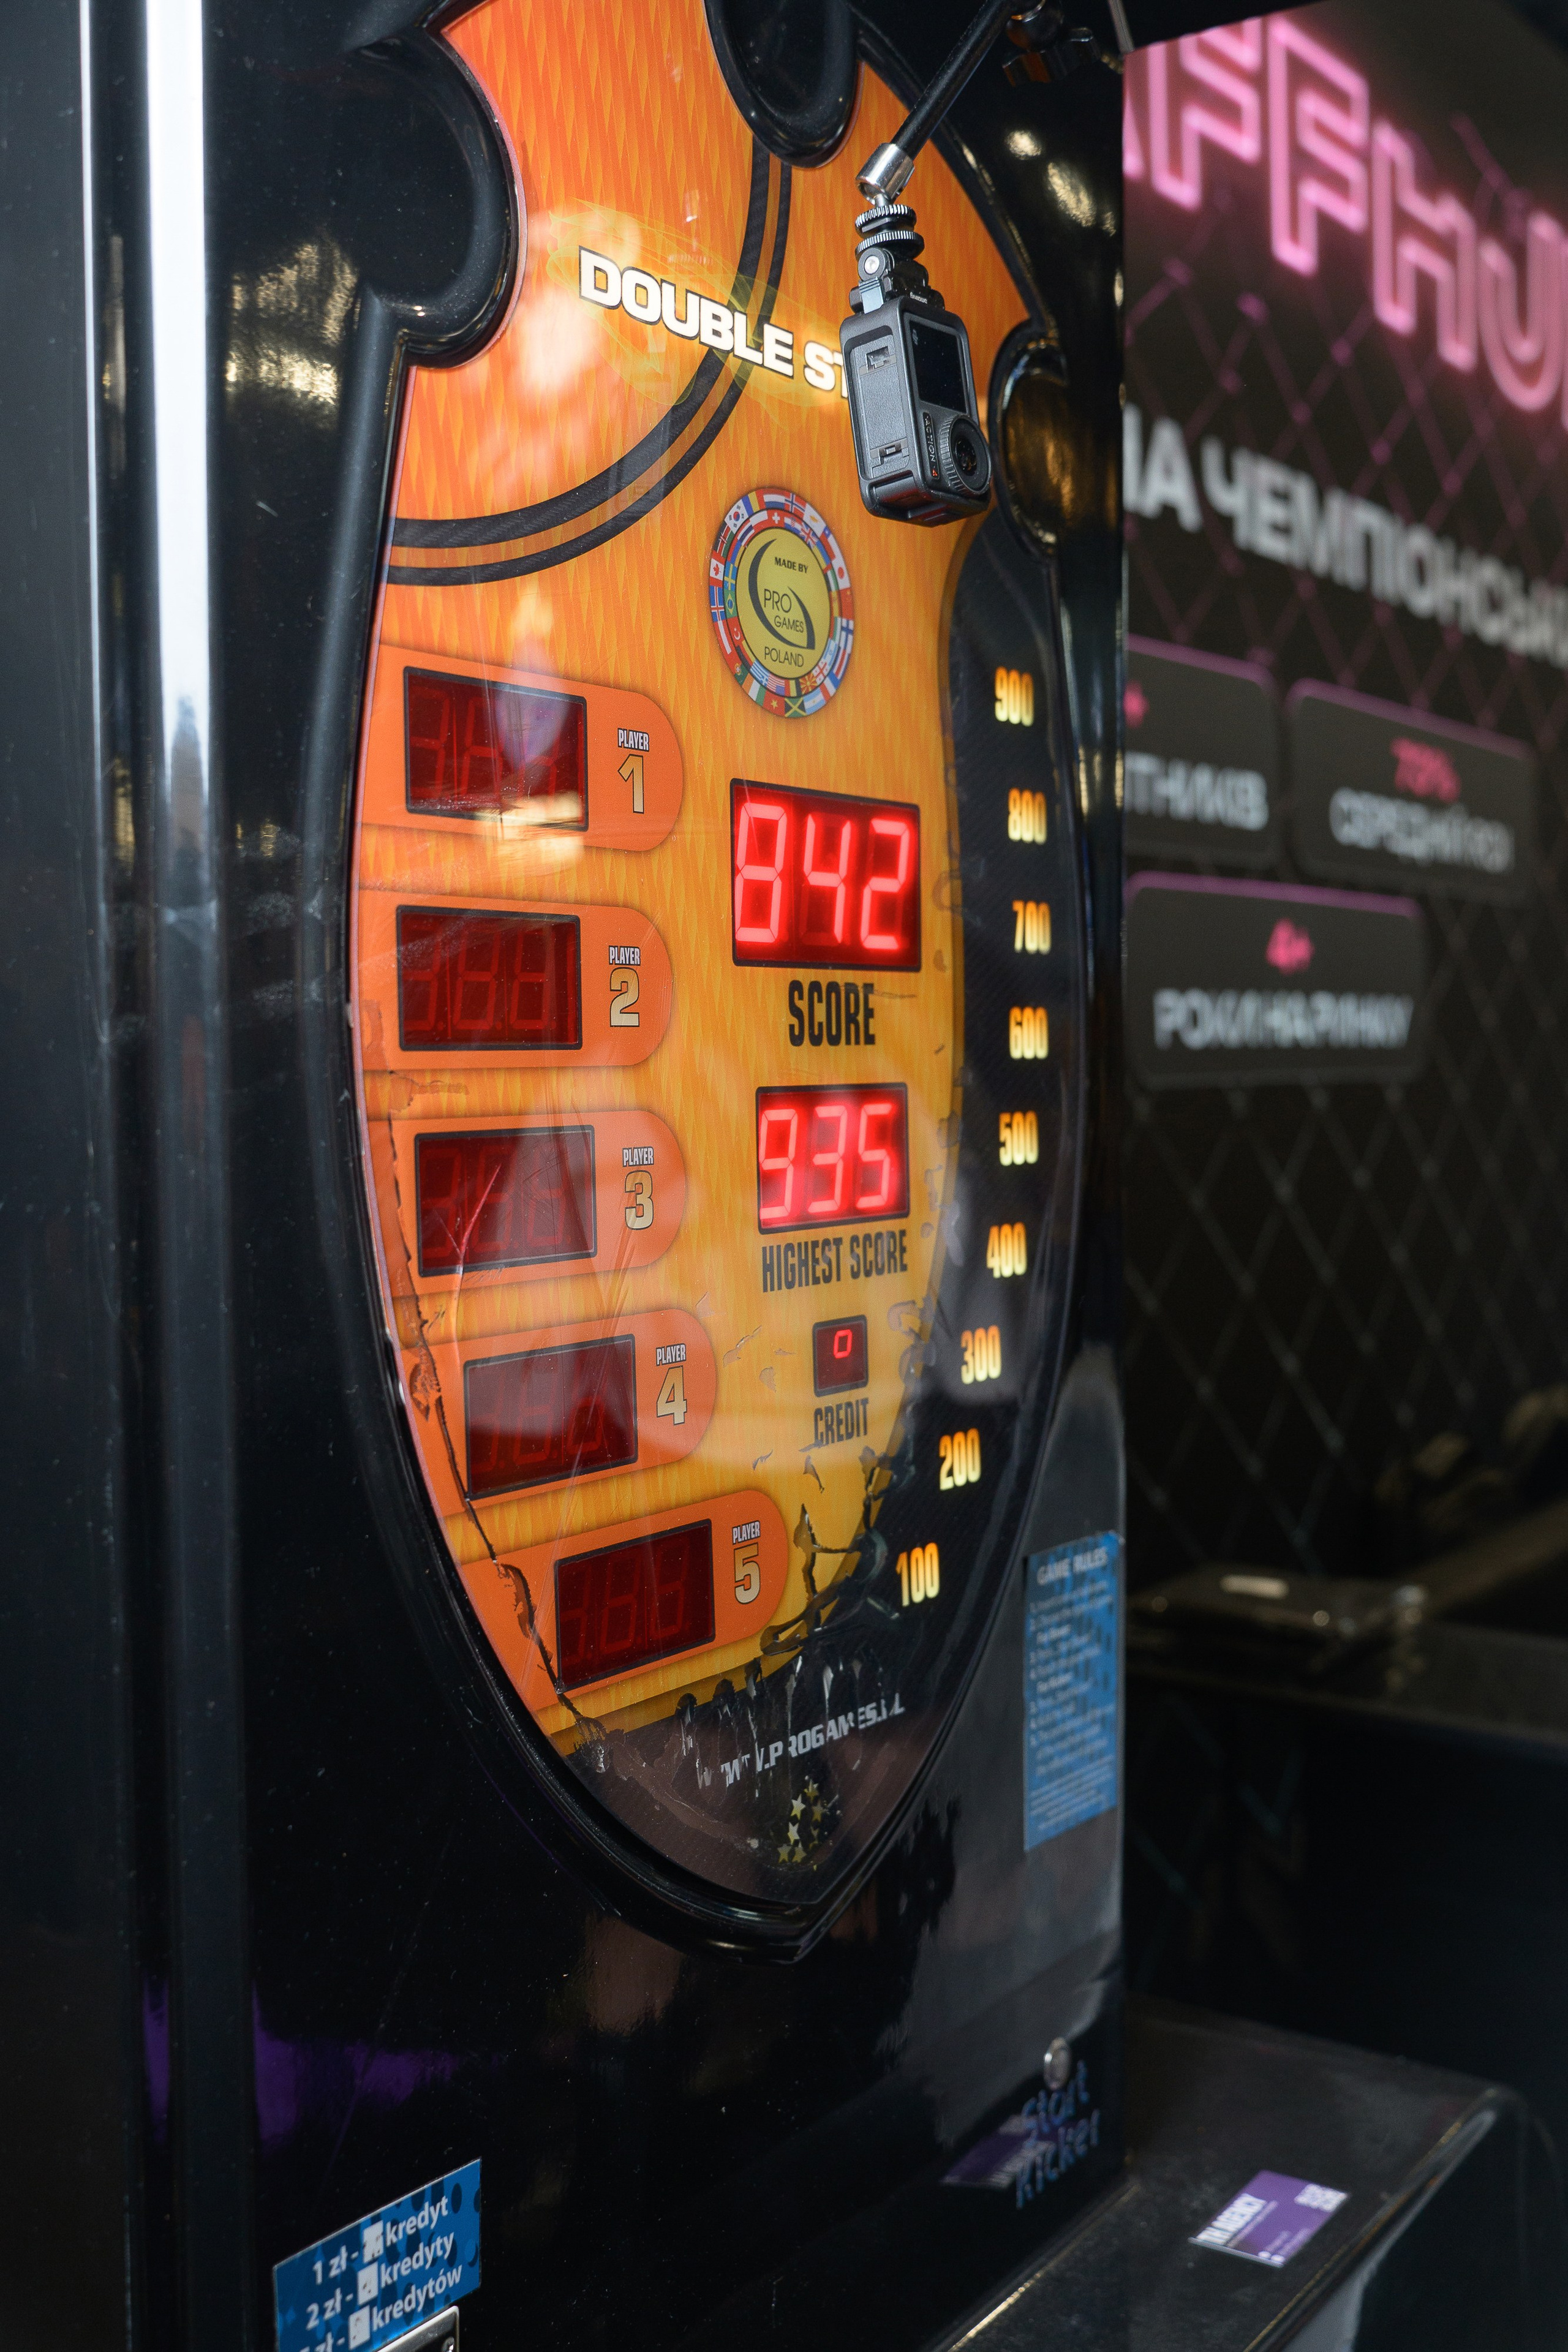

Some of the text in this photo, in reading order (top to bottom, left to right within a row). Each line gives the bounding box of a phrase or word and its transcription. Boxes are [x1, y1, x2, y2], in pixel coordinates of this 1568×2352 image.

[579, 246, 794, 379] DOUBLE
[774, 557, 809, 575] MADE BY
[764, 588, 792, 614] PRO
[774, 614, 804, 633] GAMES
[764, 646, 805, 668] POLAND
[995, 666, 1034, 727] 900
[618, 728, 649, 752] PLAYER
[617, 753, 644, 813] 1
[1008, 788, 1047, 845] 800
[735, 802, 910, 951] 842
[609, 945, 641, 967] PLAYER
[1012, 900, 1052, 955] 700
[609, 967, 641, 1027] 2
[788, 980, 876, 1047] SCORE
[1009, 1006, 1048, 1060] 600
[623, 1147, 654, 1167] PLAYER
[760, 1103, 894, 1219] 935
[999, 1110, 1039, 1166] 500
[624, 1170, 654, 1230] 3
[762, 1230, 908, 1293] HIGHEST SCORE
[987, 1222, 1027, 1279] 400
[655, 1343, 687, 1366] PLAYER
[834, 1329, 852, 1359] 0
[961, 1325, 1001, 1385] 300
[656, 1366, 687, 1425] 4
[813, 1398, 869, 1447] CREDIT
[940, 1428, 981, 1491] 200
[732, 1520, 761, 1544] PLAYER
[734, 1543, 761, 1605] 5
[896, 1542, 940, 1607] 100
[312, 2260, 323, 2285] 1
[328, 2244, 348, 2278] zł
[385, 2195, 448, 2247] kredyt
[306, 2302, 320, 2331] 2
[323, 2288, 342, 2321] zł
[380, 2232, 454, 2289] kredyty
[372, 2264, 463, 2332] kredytów
